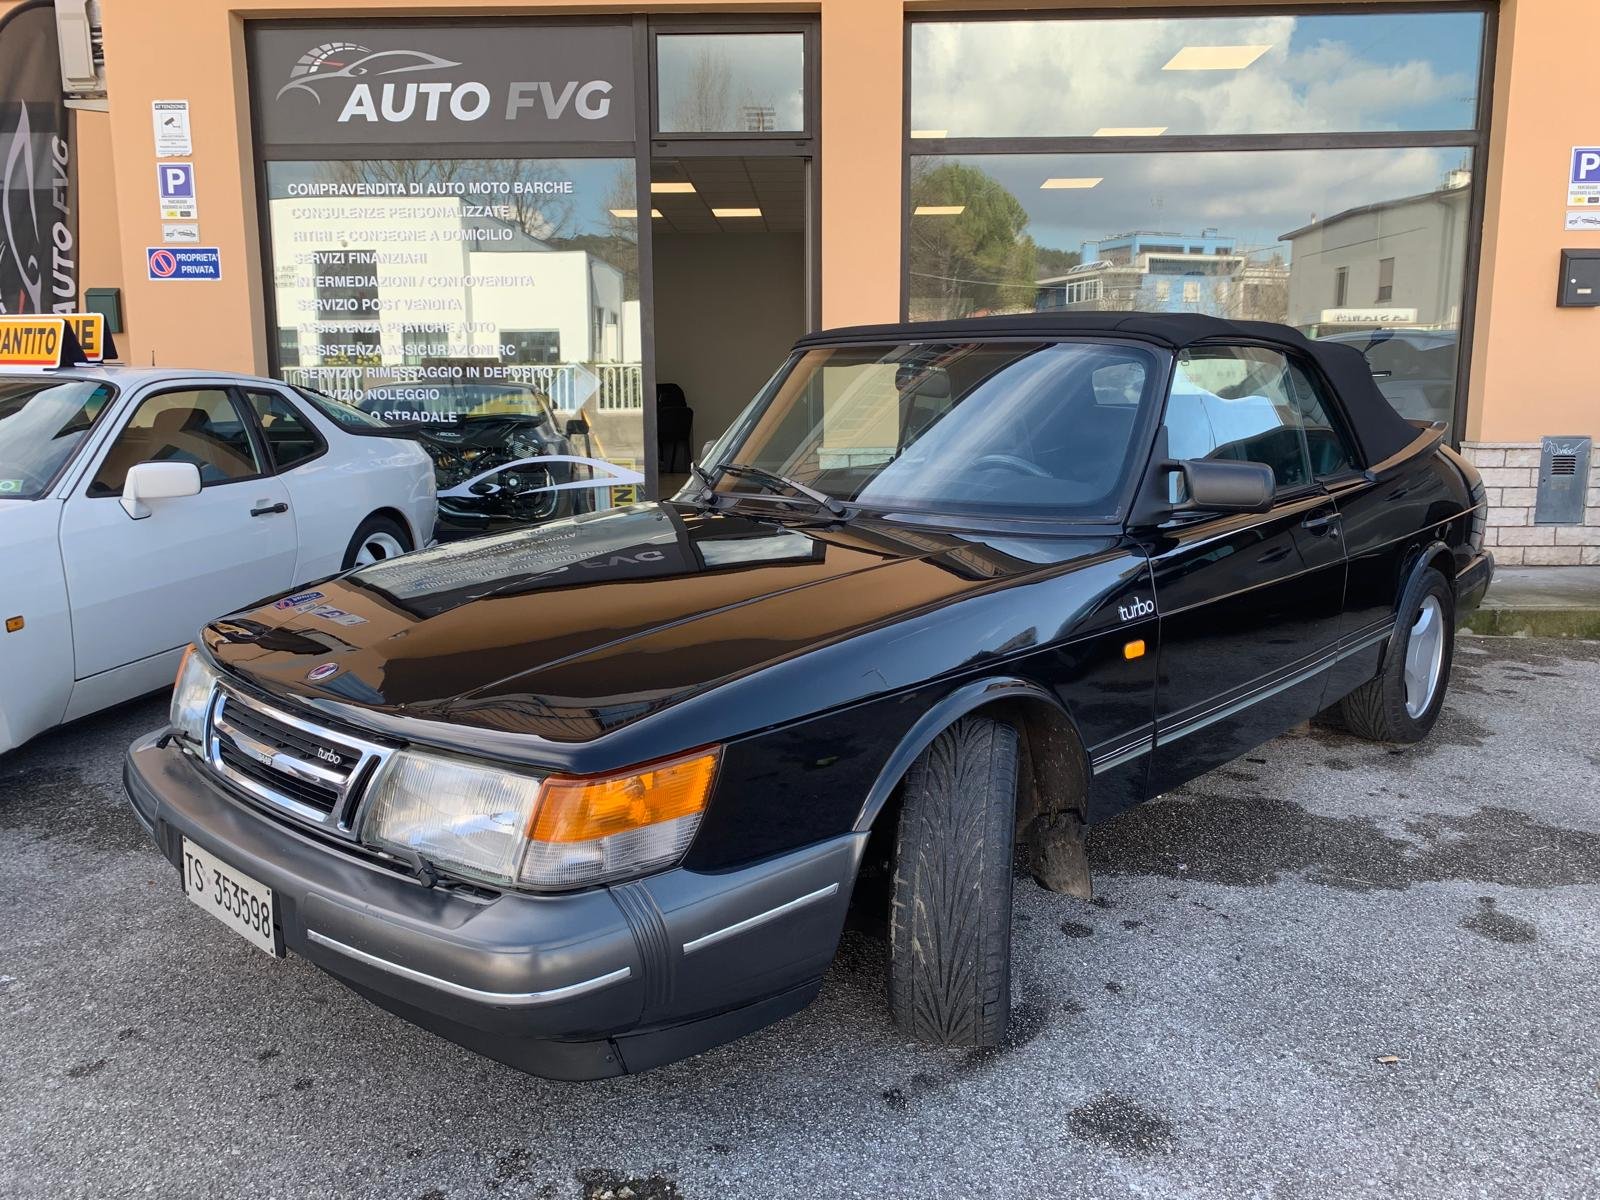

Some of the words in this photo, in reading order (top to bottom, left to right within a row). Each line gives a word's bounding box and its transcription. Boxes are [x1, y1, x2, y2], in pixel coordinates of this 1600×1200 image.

[337, 82, 491, 122] AUTO
[505, 80, 614, 120] FVG
[1579, 153, 1600, 179] P
[52, 135, 70, 215] FVG
[166, 168, 186, 194] P
[287, 183, 407, 196] COMPRAVENDITA
[409, 183, 423, 195] DI
[427, 182, 465, 194] AUTO
[469, 182, 510, 194] MOTO
[514, 181, 573, 194] BARCHE
[291, 207, 385, 219] CONSULENZE
[389, 205, 509, 219] PERSONALIZZATE
[293, 231, 332, 242] RITIRI
[337, 230, 346, 241] E
[349, 230, 427, 242] CONSEGNE
[430, 230, 441, 241] A
[443, 228, 513, 241] DOMICILIO
[176, 253, 218, 262] PROPRIETA'
[295, 252, 348, 264] SERVIZI
[350, 252, 428, 265] FINANZIARI
[181, 265, 215, 274] PRIVATA
[296, 275, 416, 288] INTERMEDIAZIONI
[427, 275, 536, 288] CONTOVENDITA
[298, 298, 358, 311] SERVIZIO
[362, 298, 400, 311] POST
[405, 298, 463, 311] VENDITA
[299, 322, 384, 334] ASSISTENZA
[388, 322, 455, 334] PRATICHE
[461, 322, 497, 334] AUTO
[299, 344, 384, 356] ASSISTENZA
[388, 344, 494, 356] ASSICURAZIONI
[498, 344, 516, 356] RC
[299, 367, 363, 379] SERVIZIO
[366, 367, 463, 379] RIMESSAGGIO
[466, 366, 480, 378] IN
[483, 366, 553, 379] DEPOSITO
[367, 388, 440, 401] NOLEGGIO
[384, 410, 458, 423] STRADALE
[1118, 596, 1155, 620] turbo
[317, 747, 341, 764] turbo
[185, 852, 204, 892] TS
[213, 868, 271, 939] 353598
